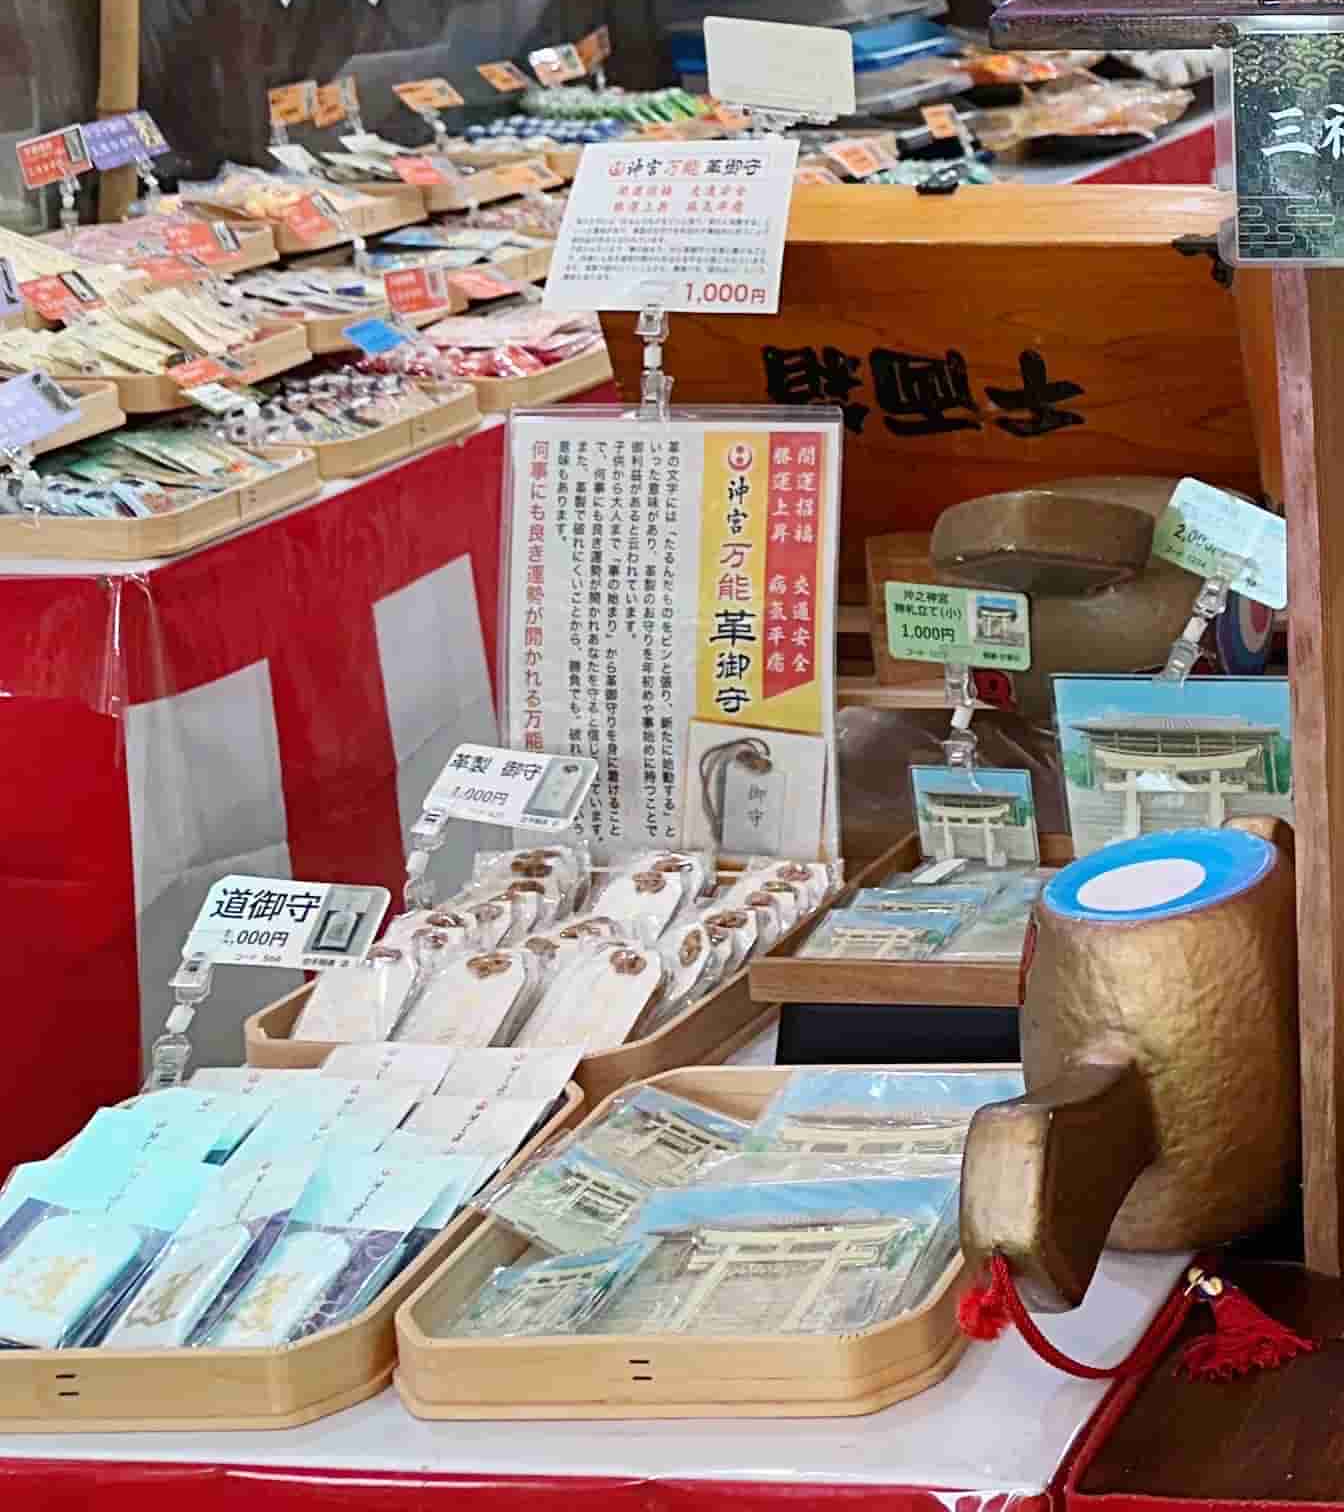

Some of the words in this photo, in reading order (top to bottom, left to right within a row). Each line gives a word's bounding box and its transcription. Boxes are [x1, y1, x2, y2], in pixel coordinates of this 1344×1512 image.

[682, 280, 766, 306] 1,000円
[208, 887, 322, 924] 道御守
